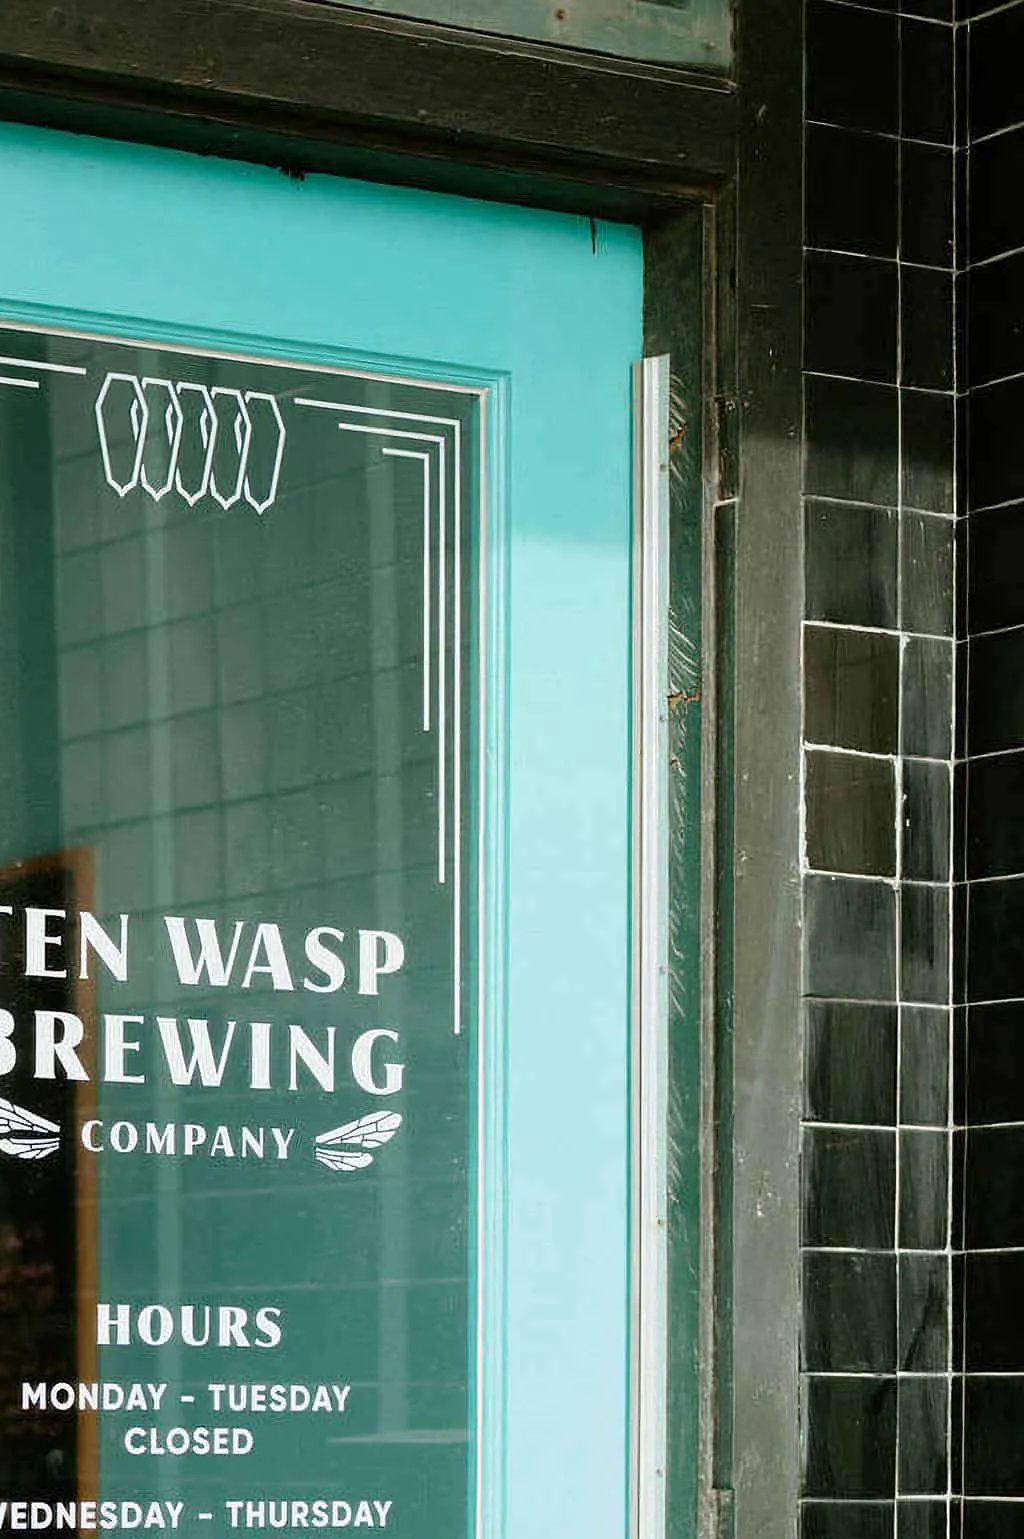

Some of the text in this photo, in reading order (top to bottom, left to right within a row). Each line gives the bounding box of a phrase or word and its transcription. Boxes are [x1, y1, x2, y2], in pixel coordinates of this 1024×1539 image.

[163, 916, 405, 995] WASP
[81, 1119, 294, 1159] COMPANY
[96, 1303, 282, 1348] HOURS
[22, 1382, 167, 1411] MONDAY
[207, 1383, 351, 1412] TUESDAY
[124, 1427, 254, 1455] CLOSED
[225, 1500, 393, 1528] THURSDAY
